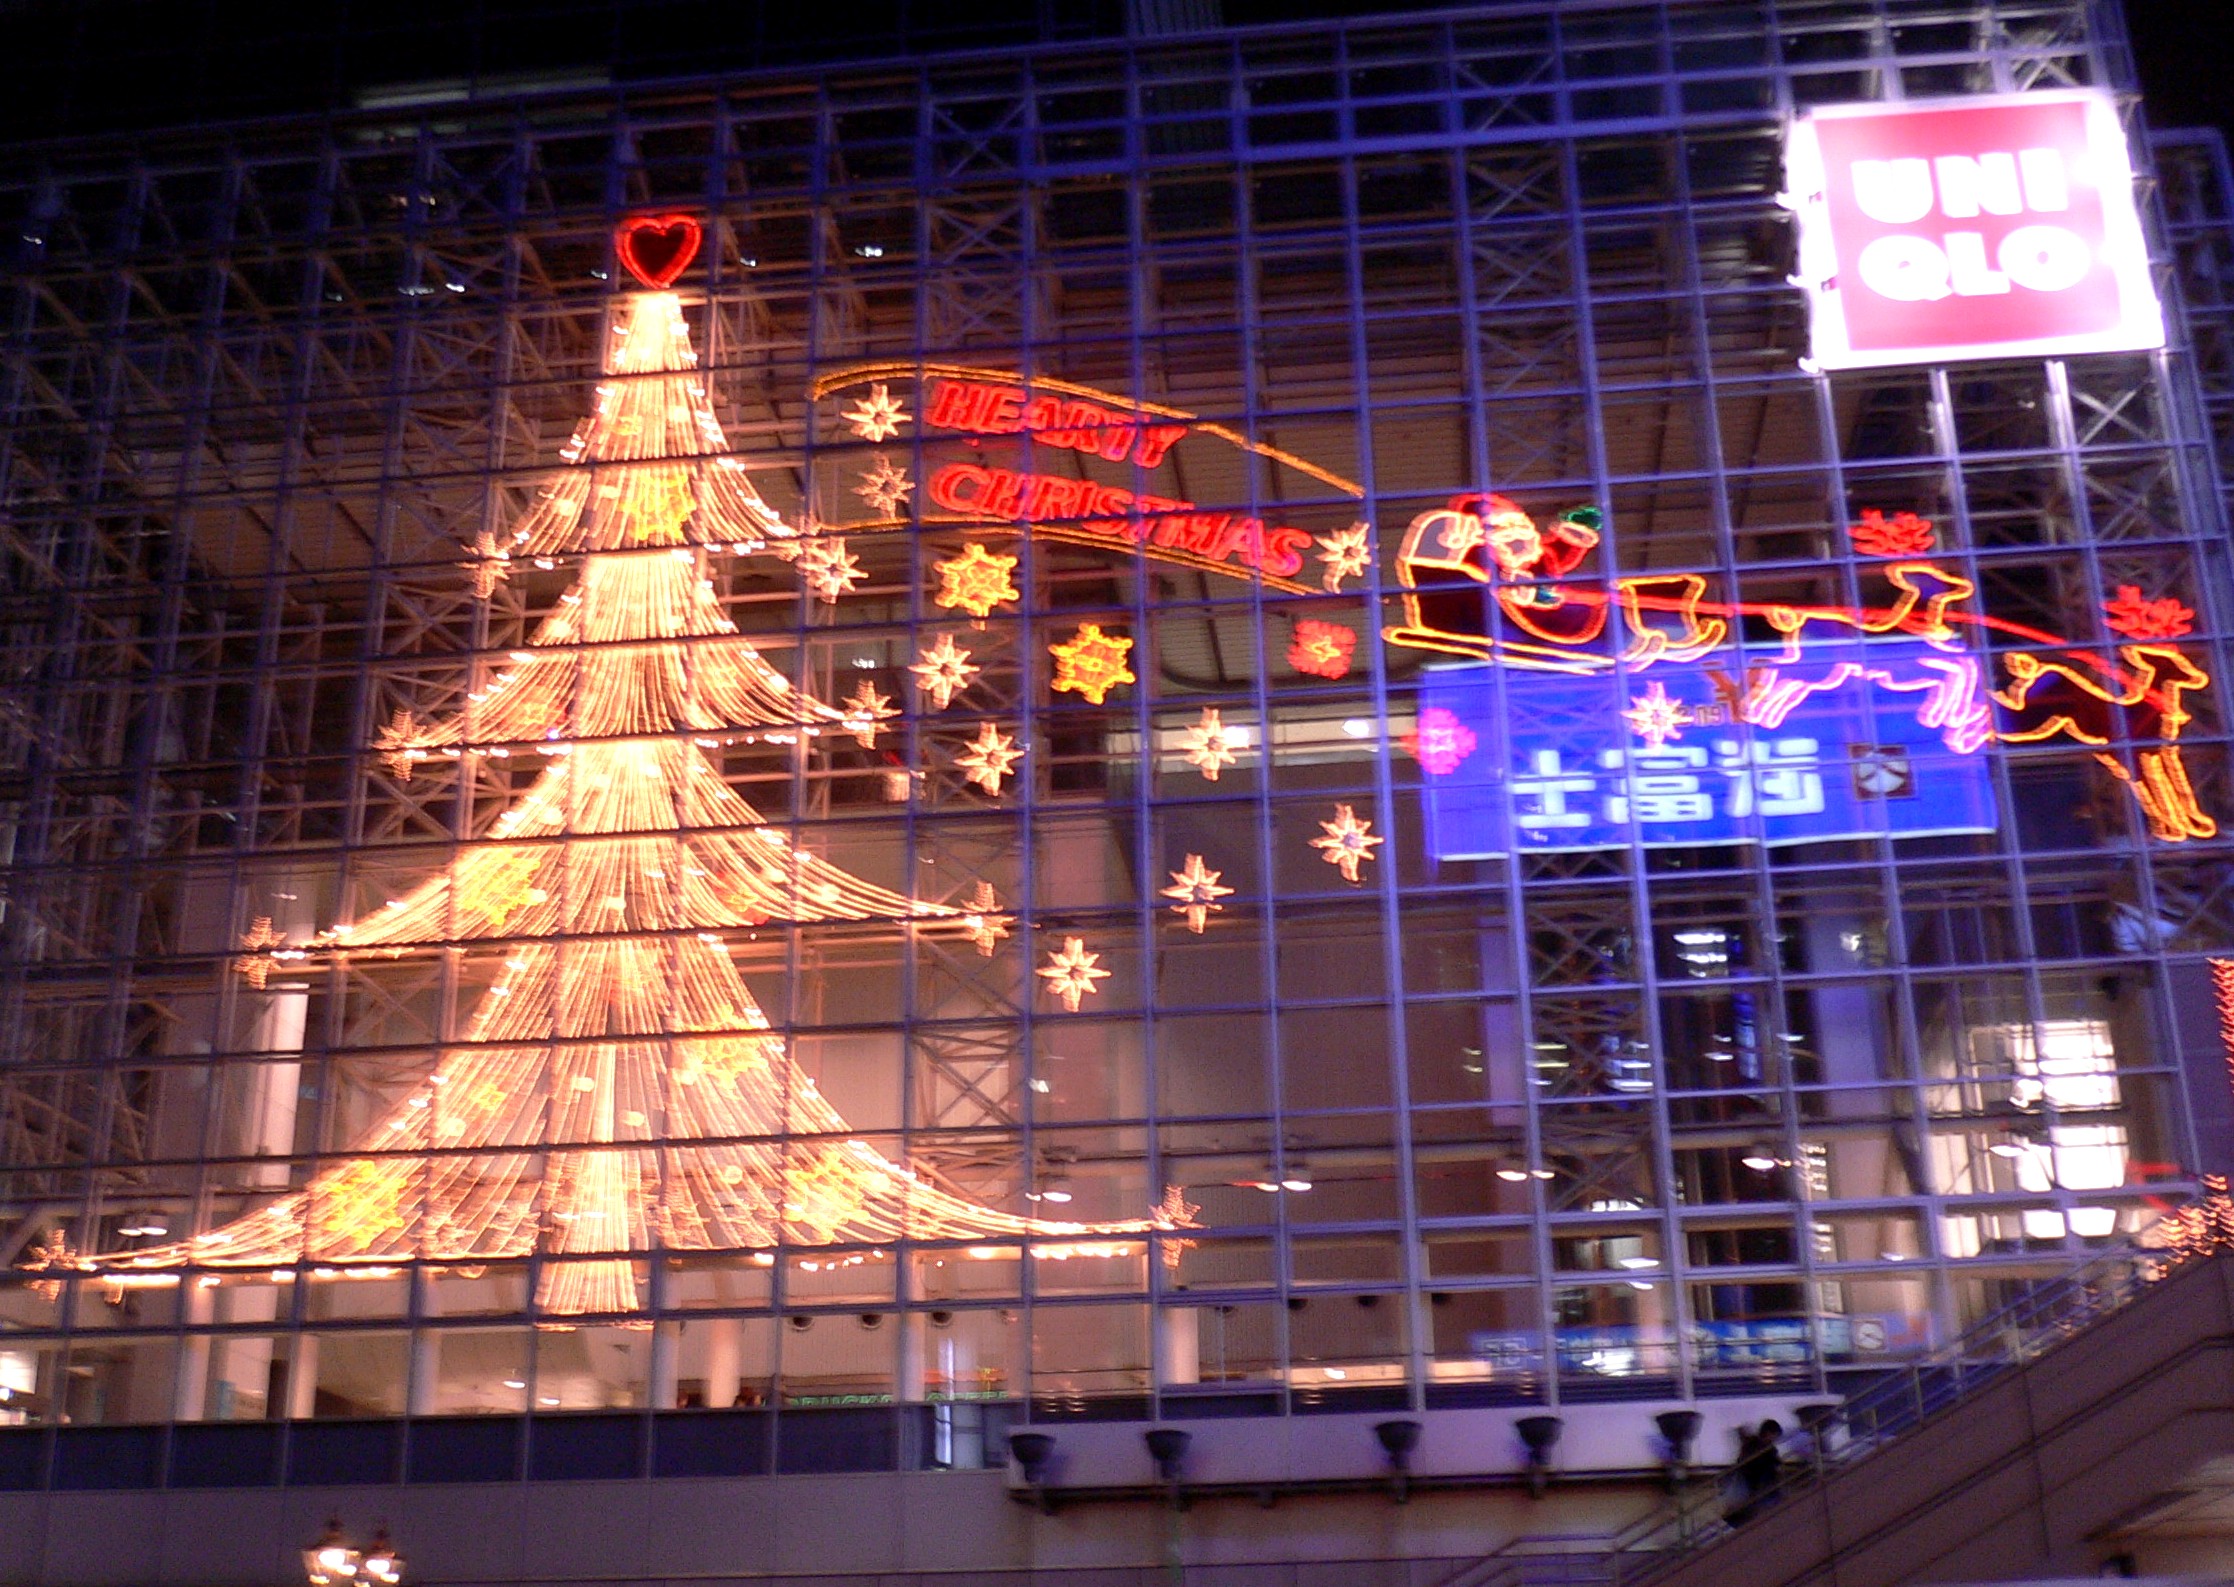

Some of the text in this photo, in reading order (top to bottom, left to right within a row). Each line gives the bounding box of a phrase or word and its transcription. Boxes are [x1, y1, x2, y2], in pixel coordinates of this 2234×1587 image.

[1851, 147, 2068, 224] UNI
[1858, 225, 2091, 301] QLO
[925, 380, 1188, 468] HEARTY
[928, 462, 1312, 577] CHRISTMAS
